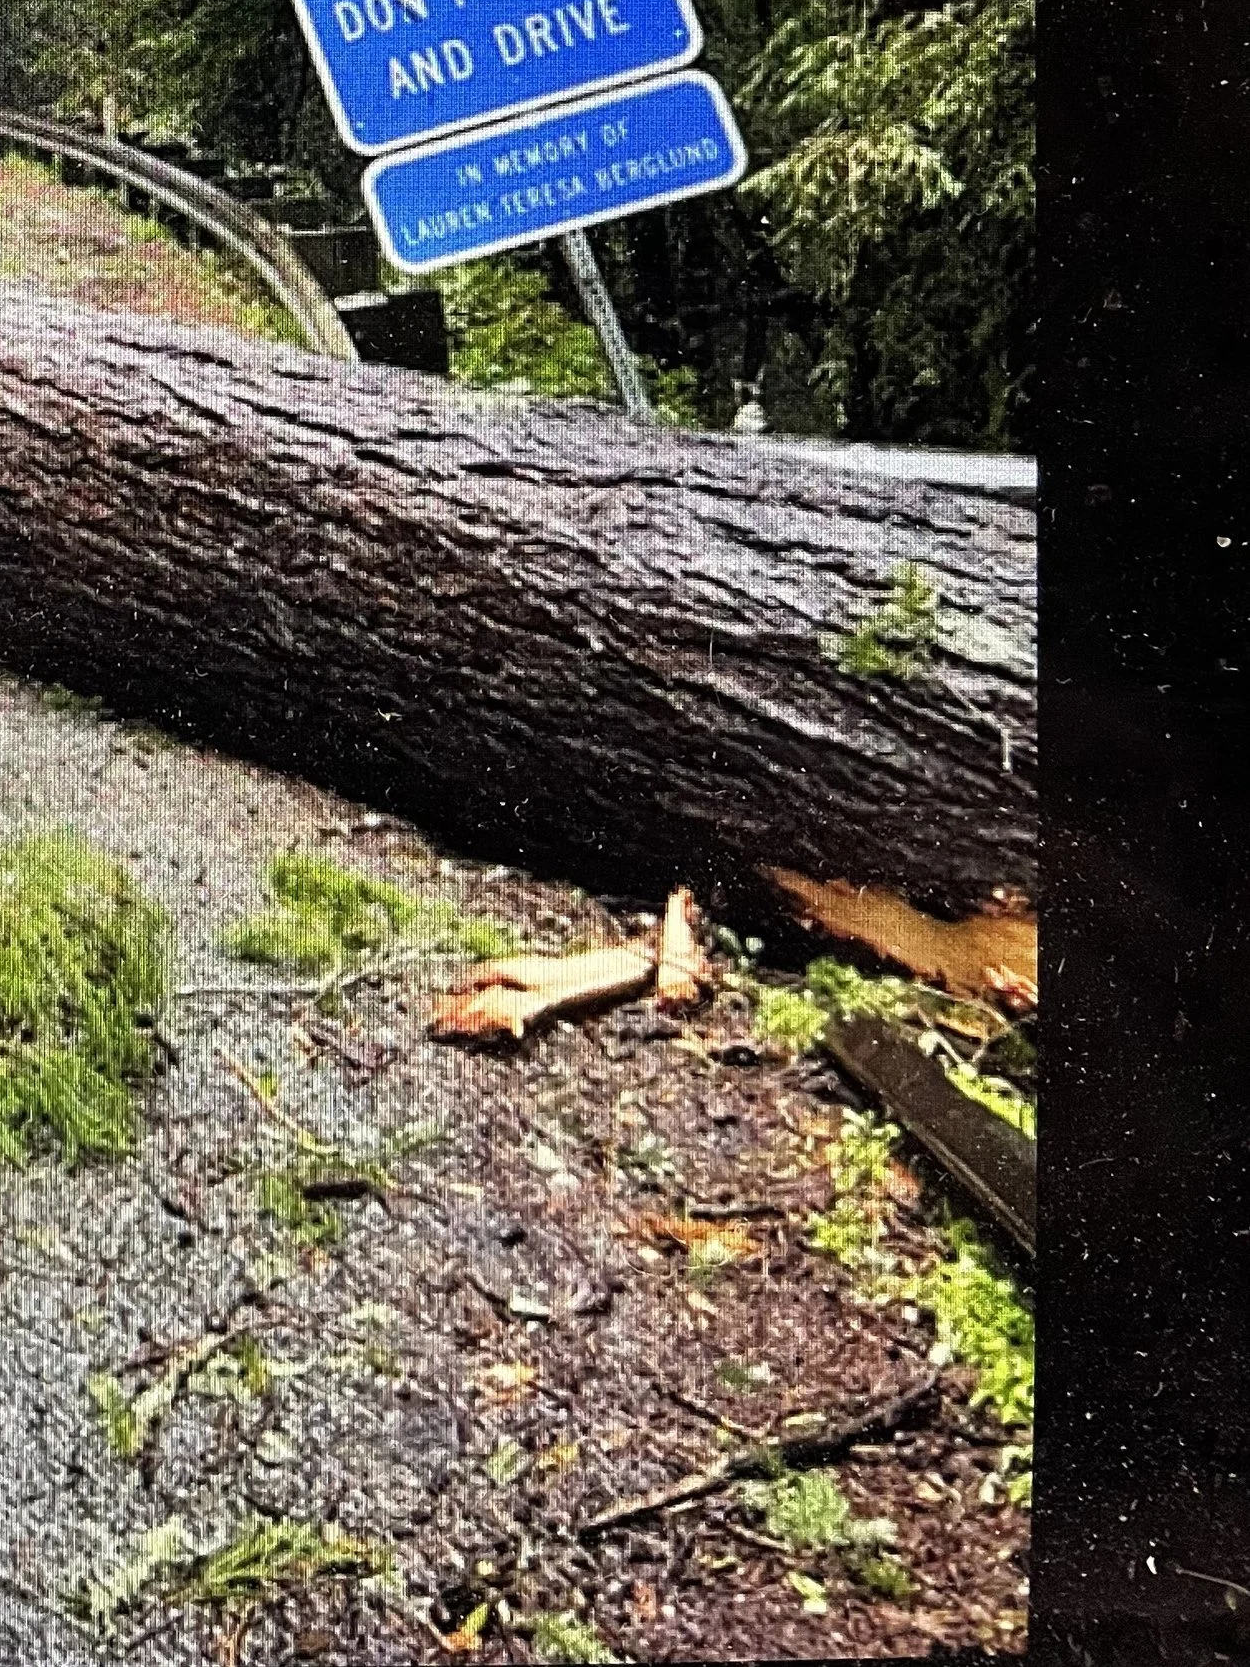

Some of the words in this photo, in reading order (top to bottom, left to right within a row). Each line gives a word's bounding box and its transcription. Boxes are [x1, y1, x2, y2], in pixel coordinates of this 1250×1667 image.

[389, 40, 474, 100] AND
[456, 166, 483, 188] IN
[493, 130, 587, 176] MEMORY
[603, 118, 629, 146] OF
[400, 200, 493, 246] LAUREN
[500, 174, 588, 215] TERESA
